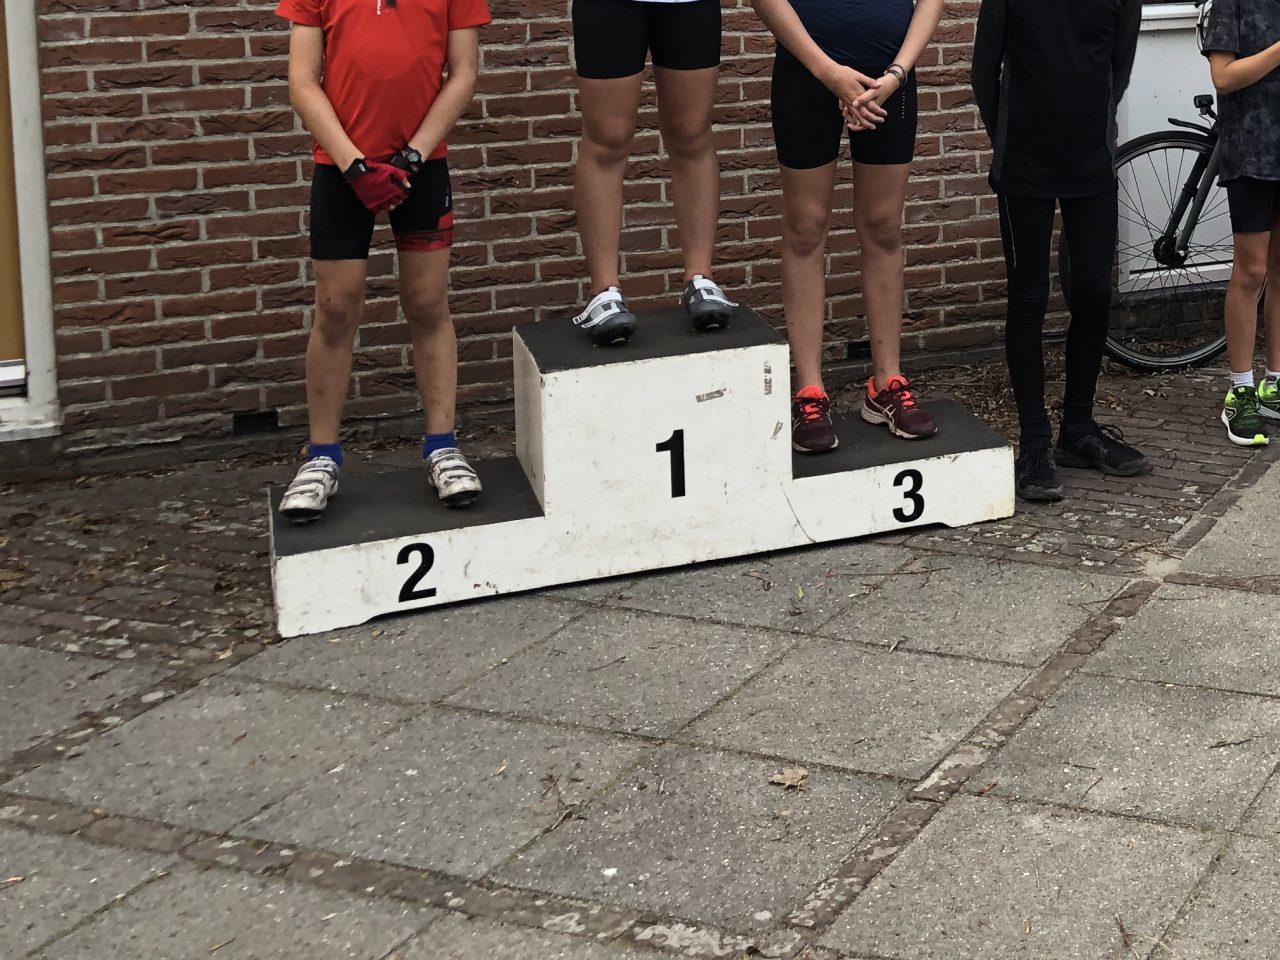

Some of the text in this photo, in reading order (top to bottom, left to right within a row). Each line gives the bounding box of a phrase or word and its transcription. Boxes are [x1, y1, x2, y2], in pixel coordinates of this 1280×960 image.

[655, 428, 686, 498] 1
[892, 468, 925, 523] 3
[397, 543, 437, 602] 2
